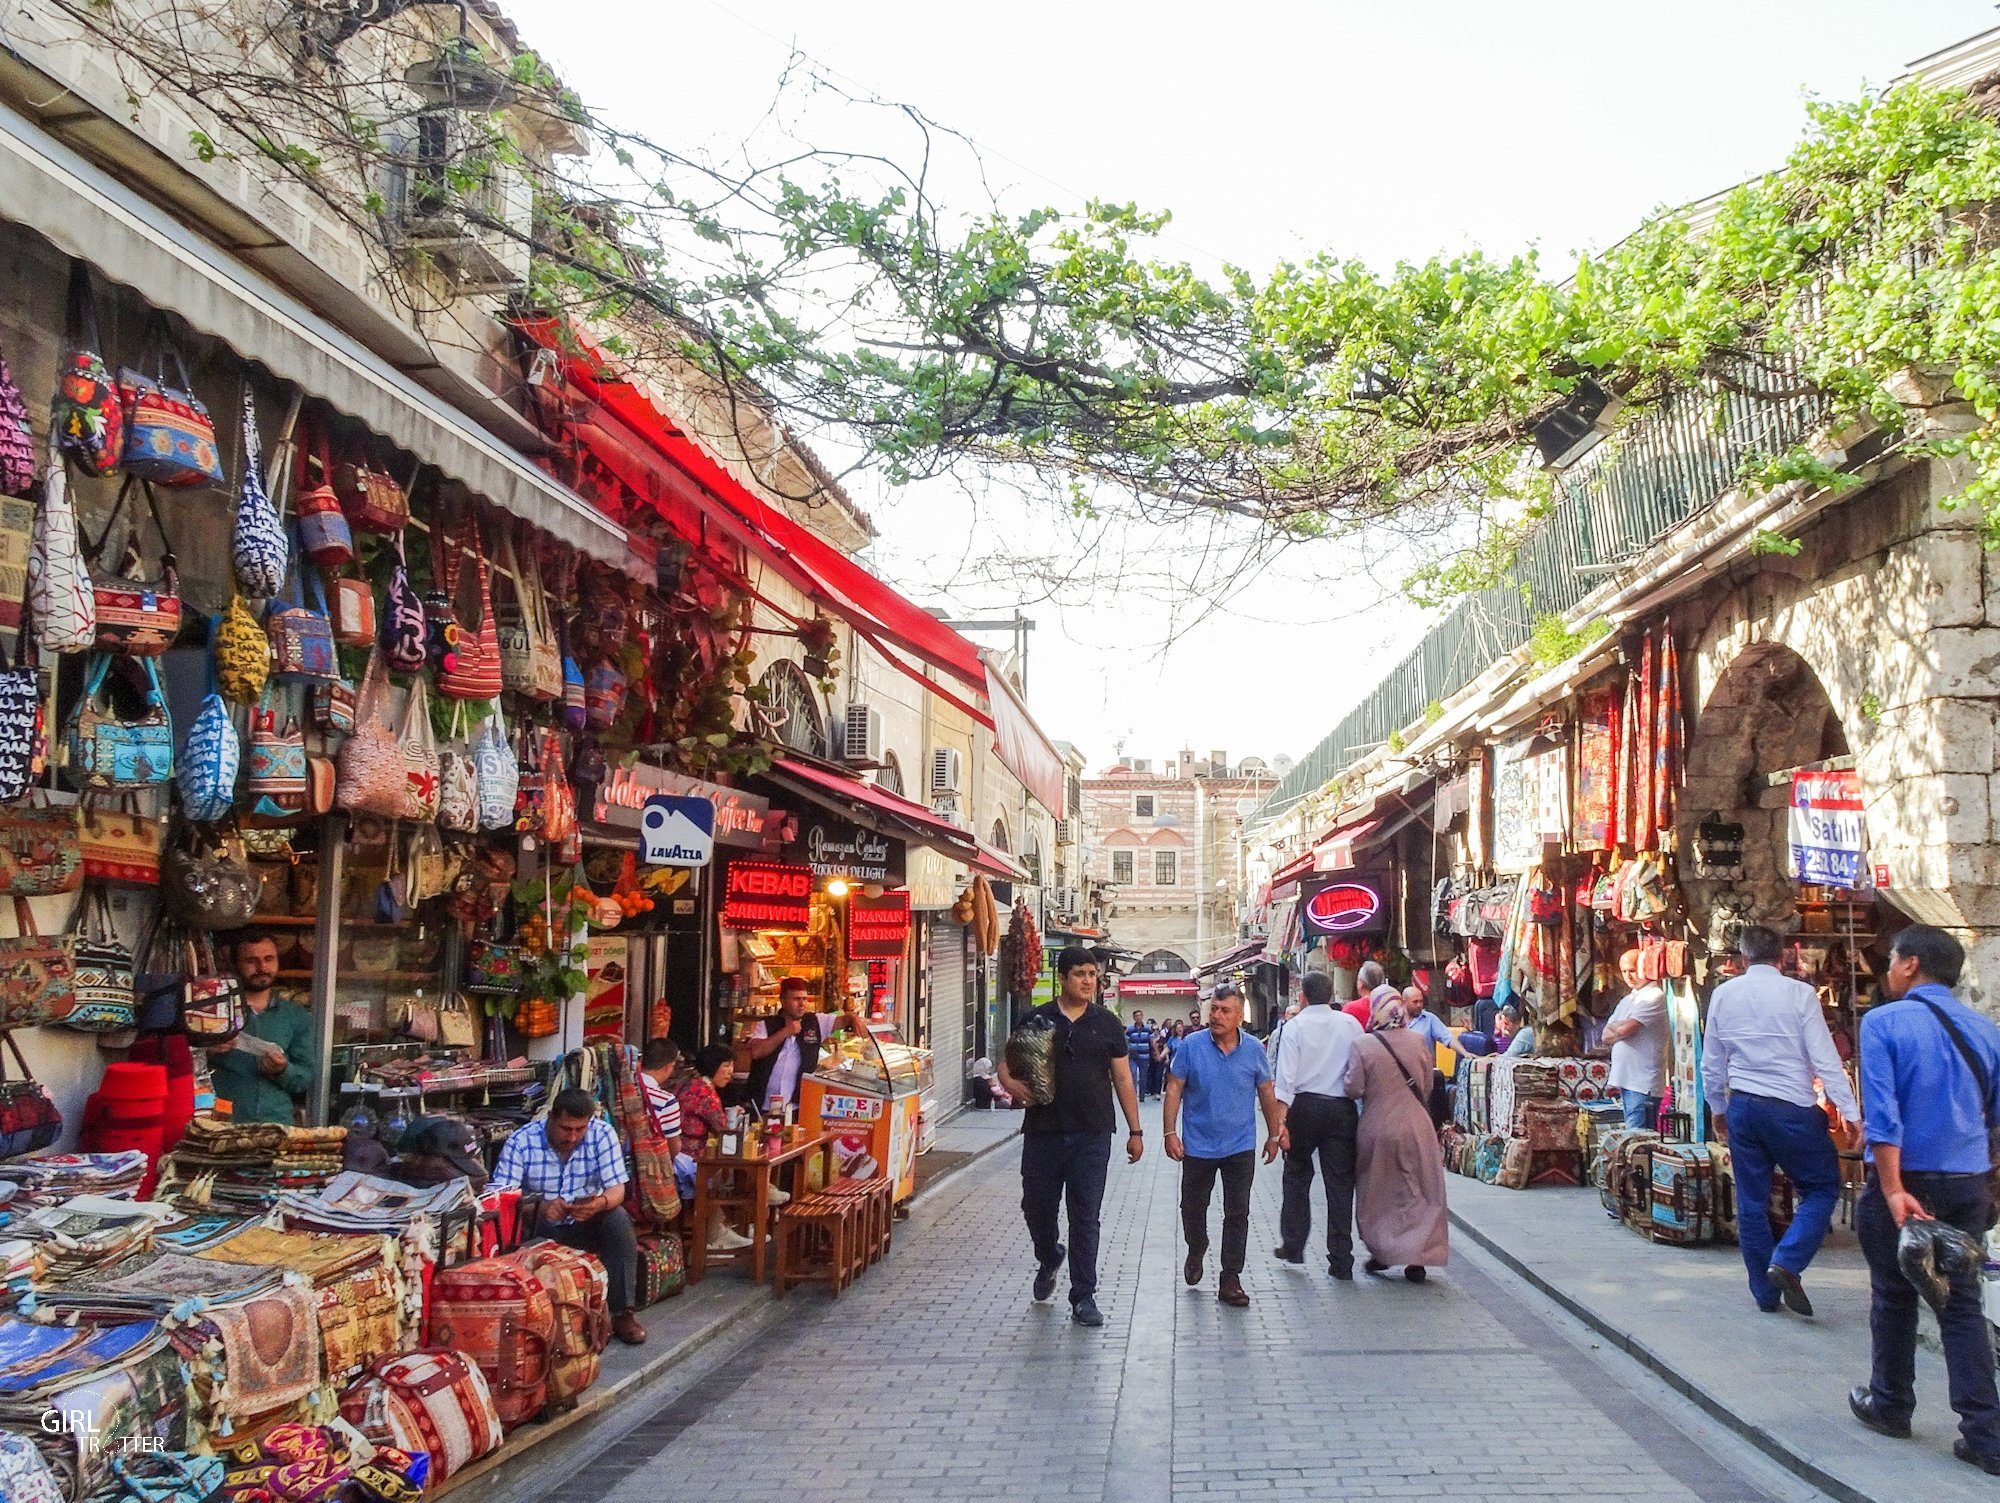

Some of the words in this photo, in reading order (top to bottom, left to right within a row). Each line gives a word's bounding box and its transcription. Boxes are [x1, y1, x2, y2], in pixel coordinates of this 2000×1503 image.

[1812, 816, 1862, 842] Satılı
[650, 844, 703, 860] LAVAZZA
[808, 862, 849, 877] TURKISH
[850, 866, 887, 880] DELIGHT
[732, 870, 809, 897] KEBAB
[727, 902, 809, 922] SANDWICH
[855, 910, 903, 923] IRANIAN
[853, 926, 906, 941] SAFFRON
[837, 1097, 868, 1111] ICE
